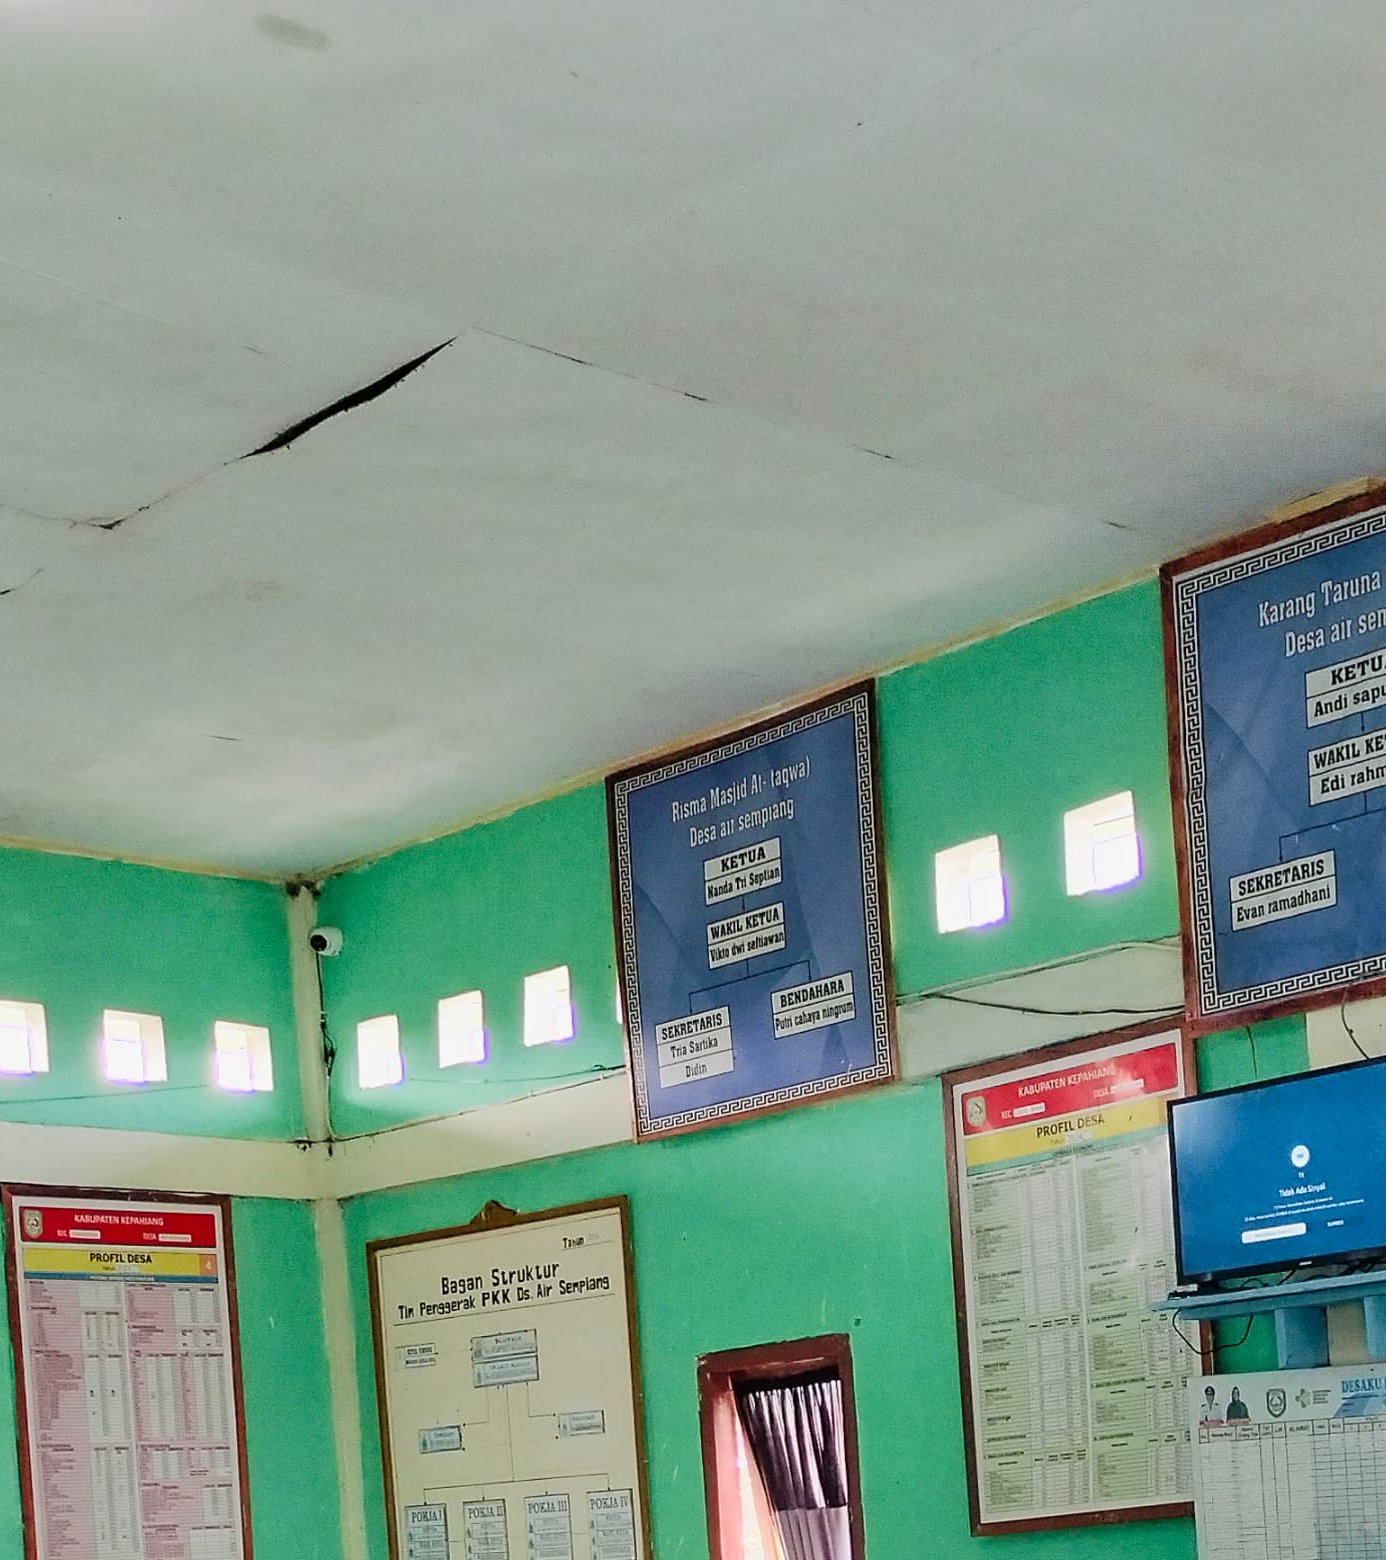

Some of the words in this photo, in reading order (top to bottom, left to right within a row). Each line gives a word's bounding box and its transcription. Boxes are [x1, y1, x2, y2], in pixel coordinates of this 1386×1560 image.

[1258, 592, 1316, 627] Karang
[1321, 571, 1381, 606] Taruna
[1285, 628, 1325, 657] Desa
[1331, 617, 1353, 643] air
[1314, 694, 1348, 717] Andi
[1314, 742, 1360, 769] WAKIL
[1320, 772, 1345, 794] Edi
[673, 796, 707, 822] Risma
[710, 777, 747, 810] Masjid
[690, 825, 717, 848] Desa
[721, 819, 734, 838] air
[739, 799, 794, 831] sempiang
[721, 846, 766, 872] KETUA
[1238, 860, 1324, 897] SEKRETARIS
[1237, 903, 1265, 923] Evan
[1268, 884, 1330, 913] ramadhani
[711, 920, 742, 939] WAKIL
[746, 908, 779, 929] KETUA
[780, 979, 845, 1008] BENDAHARA
[662, 1013, 722, 1040] SEKRETARIS
[671, 1045, 686, 1058] Tria
[689, 1037, 718, 1053] Sartika
[686, 1063, 707, 1077] Didin
[1018, 1077, 1066, 1098] KABUPATEN
[1036, 1121, 1075, 1138] PROFIL
[1078, 1113, 1105, 1129] DESA
[74, 1214, 119, 1224] KABUPATEN
[121, 1217, 164, 1226] KEPAHIANG
[563, 1236, 584, 1249] Tahun
[90, 1253, 125, 1263] PROFIL
[128, 1254, 152, 1263] DESA
[442, 1276, 482, 1295] Bagan
[492, 1263, 559, 1286] Struktur
[420, 1296, 476, 1317] Penggerak
[482, 1289, 511, 1307] PKK
[517, 1288, 533, 1301] Ds.
[537, 1284, 553, 1298] Air
[559, 1276, 610, 1295] Sempiang
[1341, 1376, 1382, 1394] DESAKU
[412, 1511, 438, 1522] POKJA
[468, 1507, 494, 1519] POKJA
[528, 1502, 556, 1514] POKJA
[590, 1498, 618, 1510] POKJA
